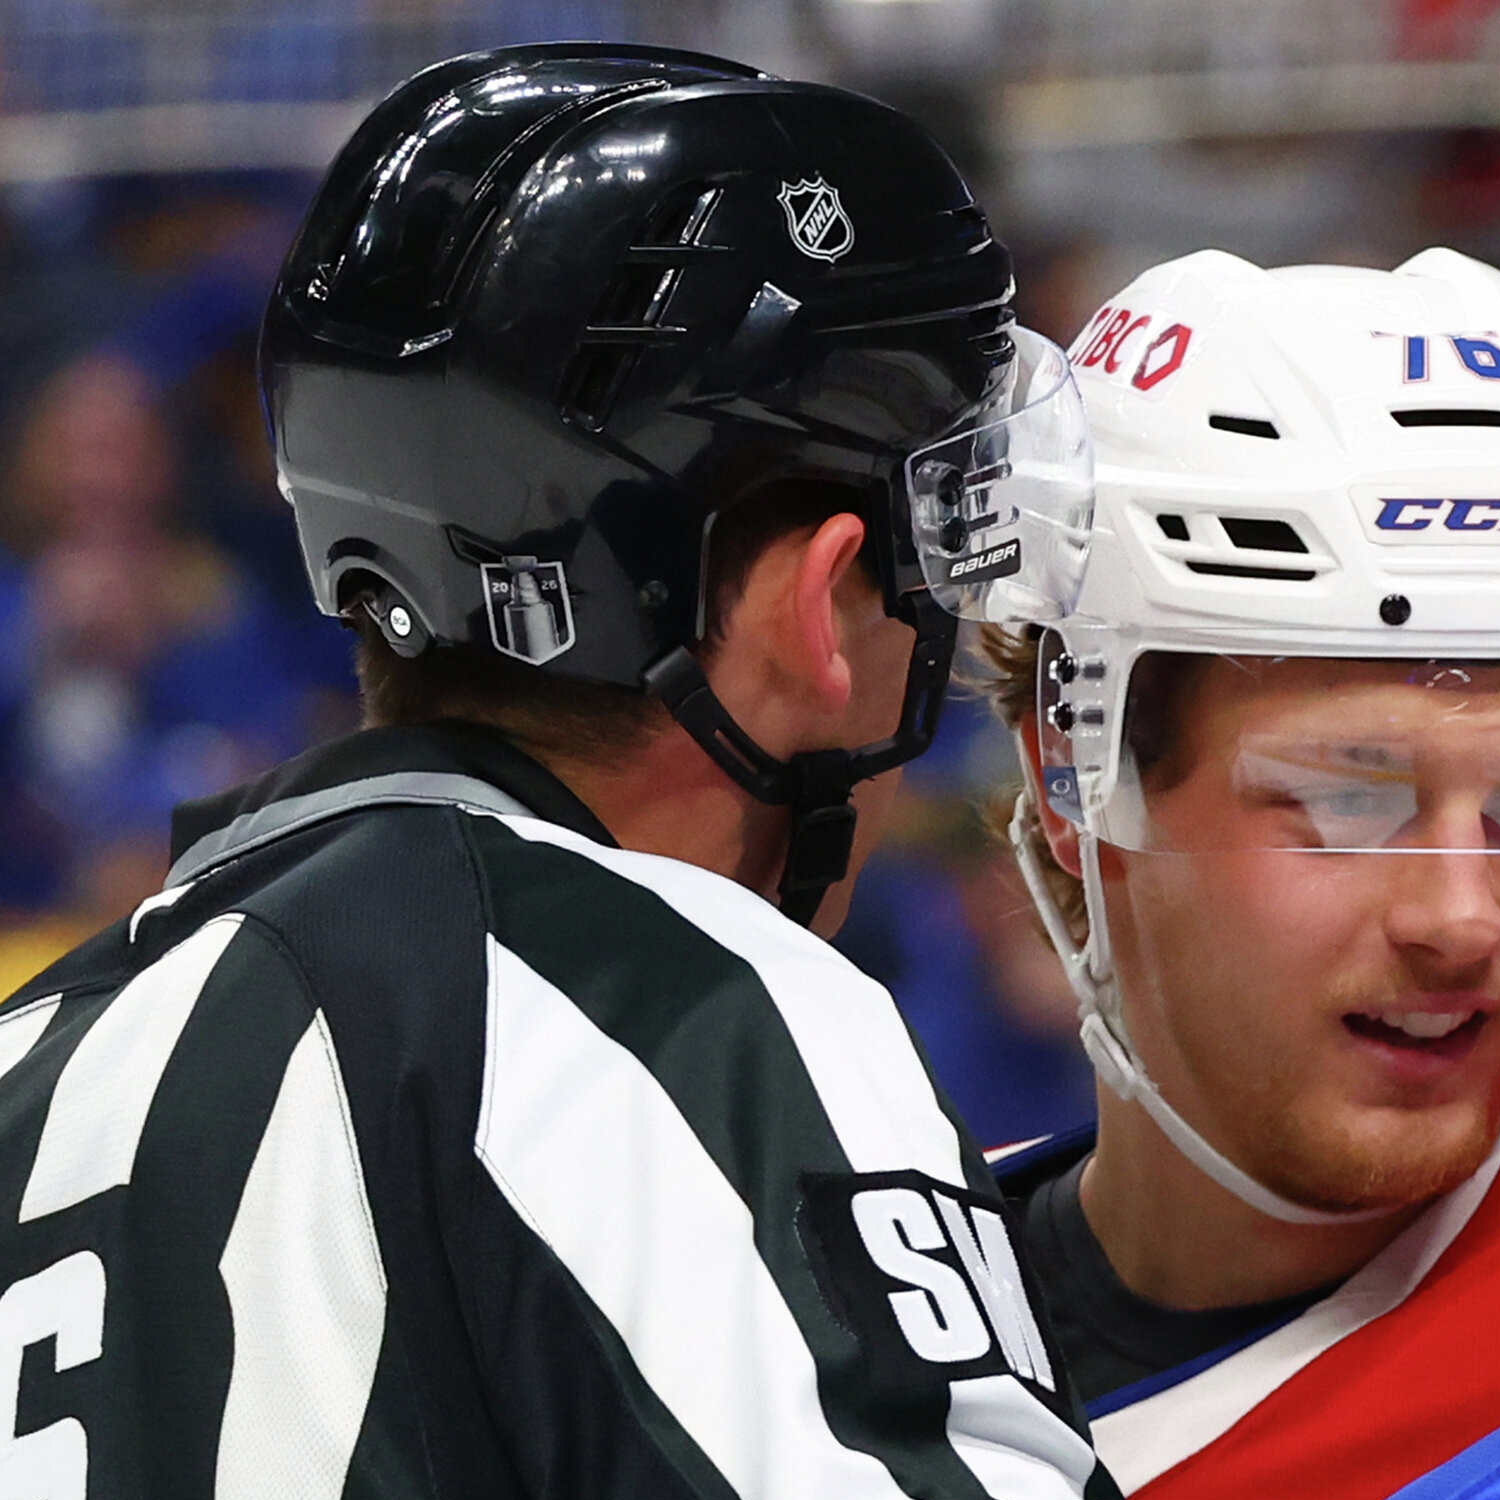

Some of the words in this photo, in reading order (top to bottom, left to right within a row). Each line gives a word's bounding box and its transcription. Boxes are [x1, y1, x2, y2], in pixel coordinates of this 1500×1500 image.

[803, 199, 834, 245] NHL
[949, 543, 1018, 578] BAUER
[492, 582, 509, 594] 20
[541, 579, 558, 591] 26
